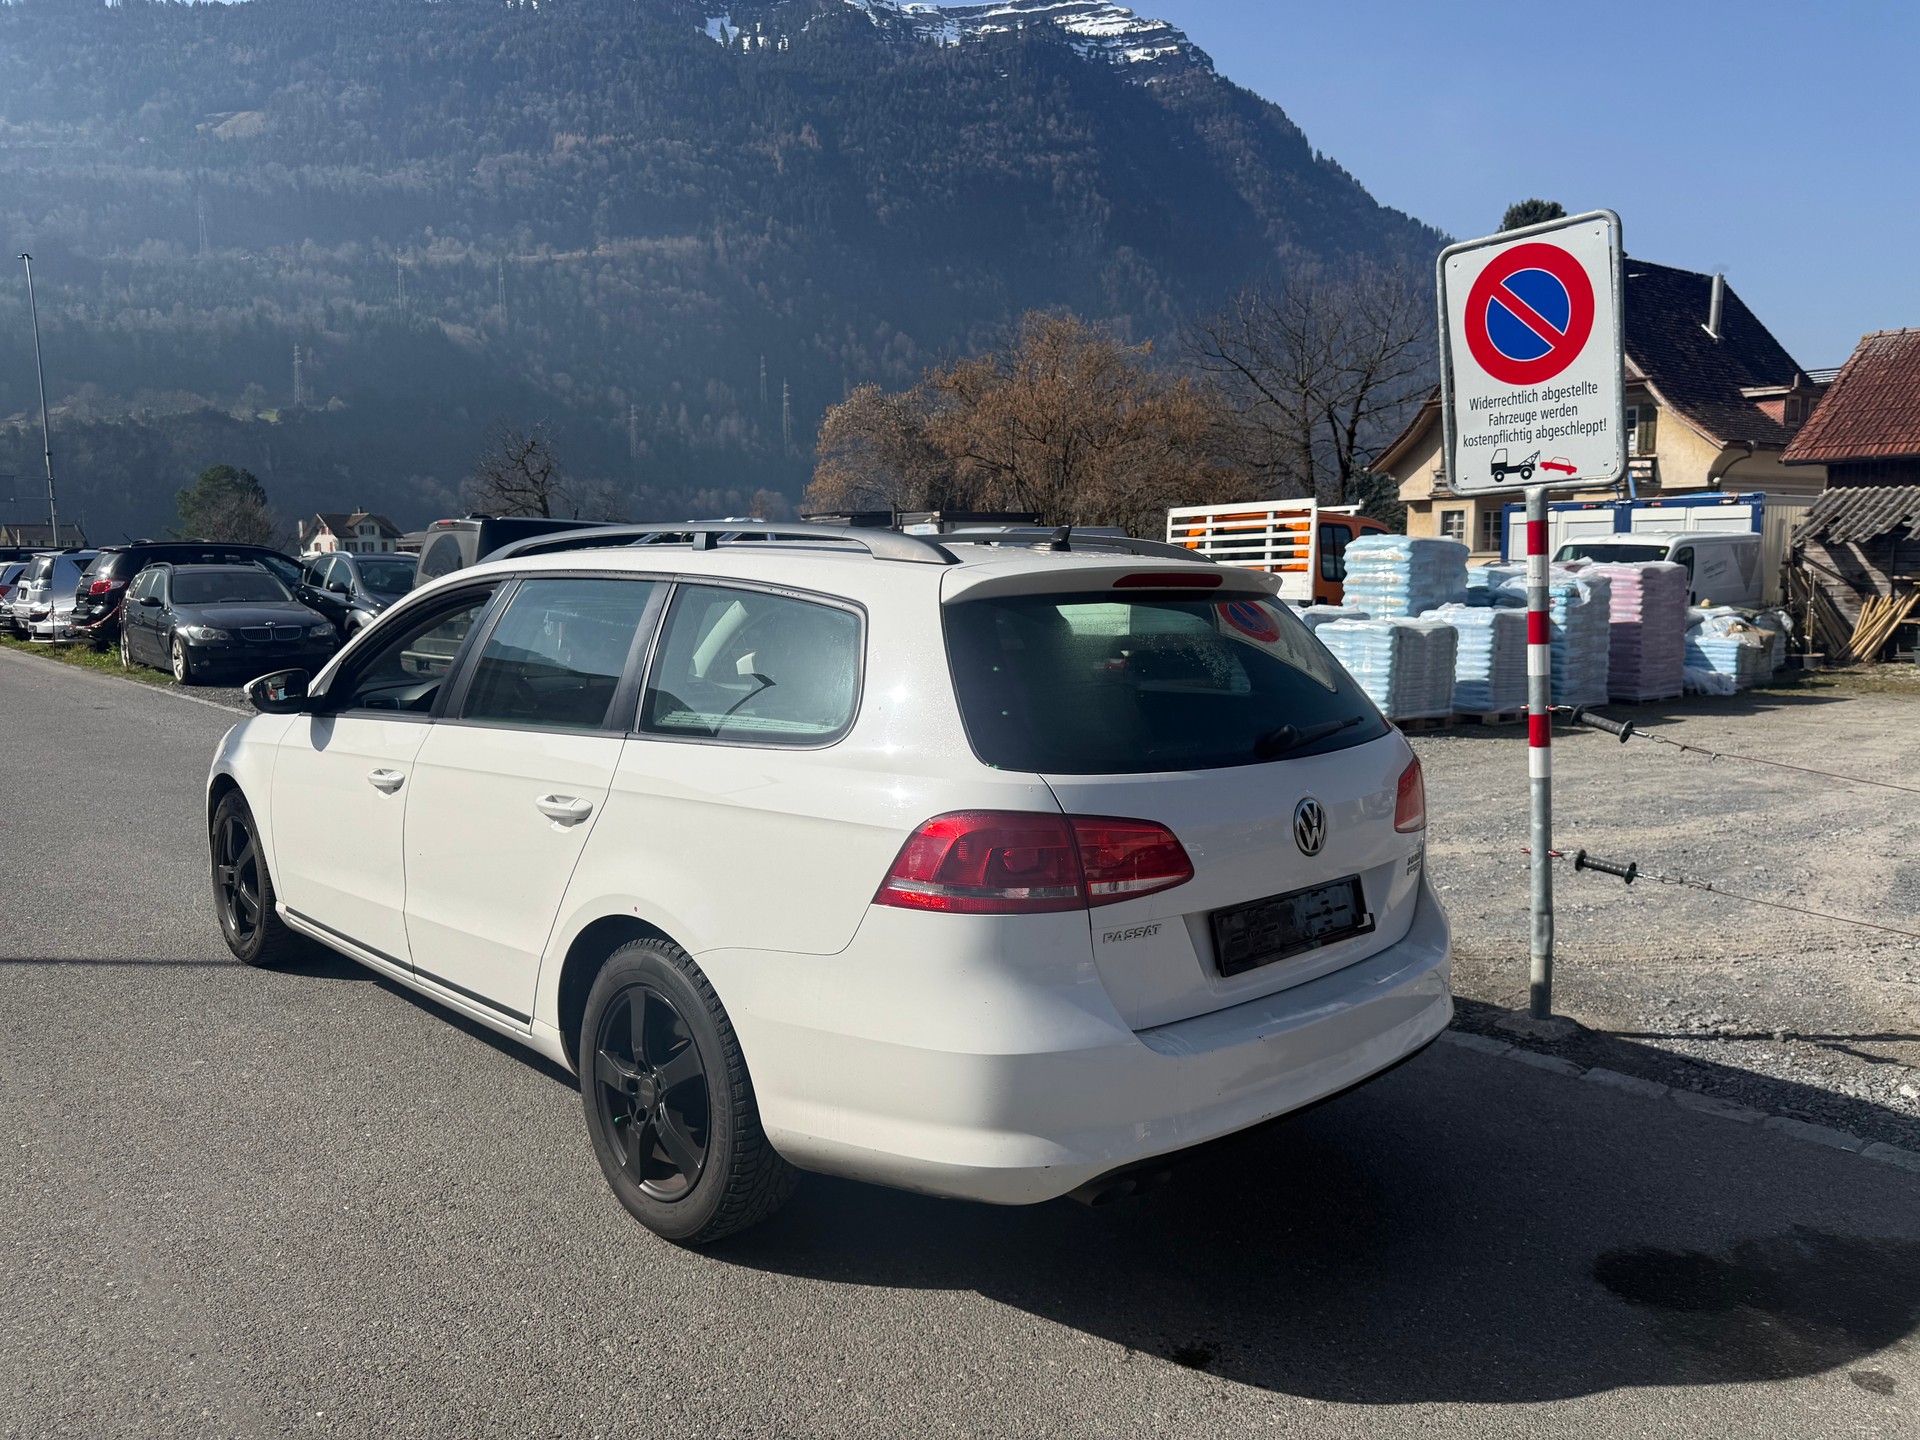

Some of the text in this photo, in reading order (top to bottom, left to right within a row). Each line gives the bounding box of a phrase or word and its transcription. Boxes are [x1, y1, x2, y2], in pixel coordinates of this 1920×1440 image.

[1469, 381, 1598, 411] Widerrechtlich abgestellte
[1488, 403, 1578, 427] Fahrzeuge werden
[1463, 418, 1607, 448] kostenpflichtig abgeschleppt!
[1102, 923, 1162, 944] PASSAT
